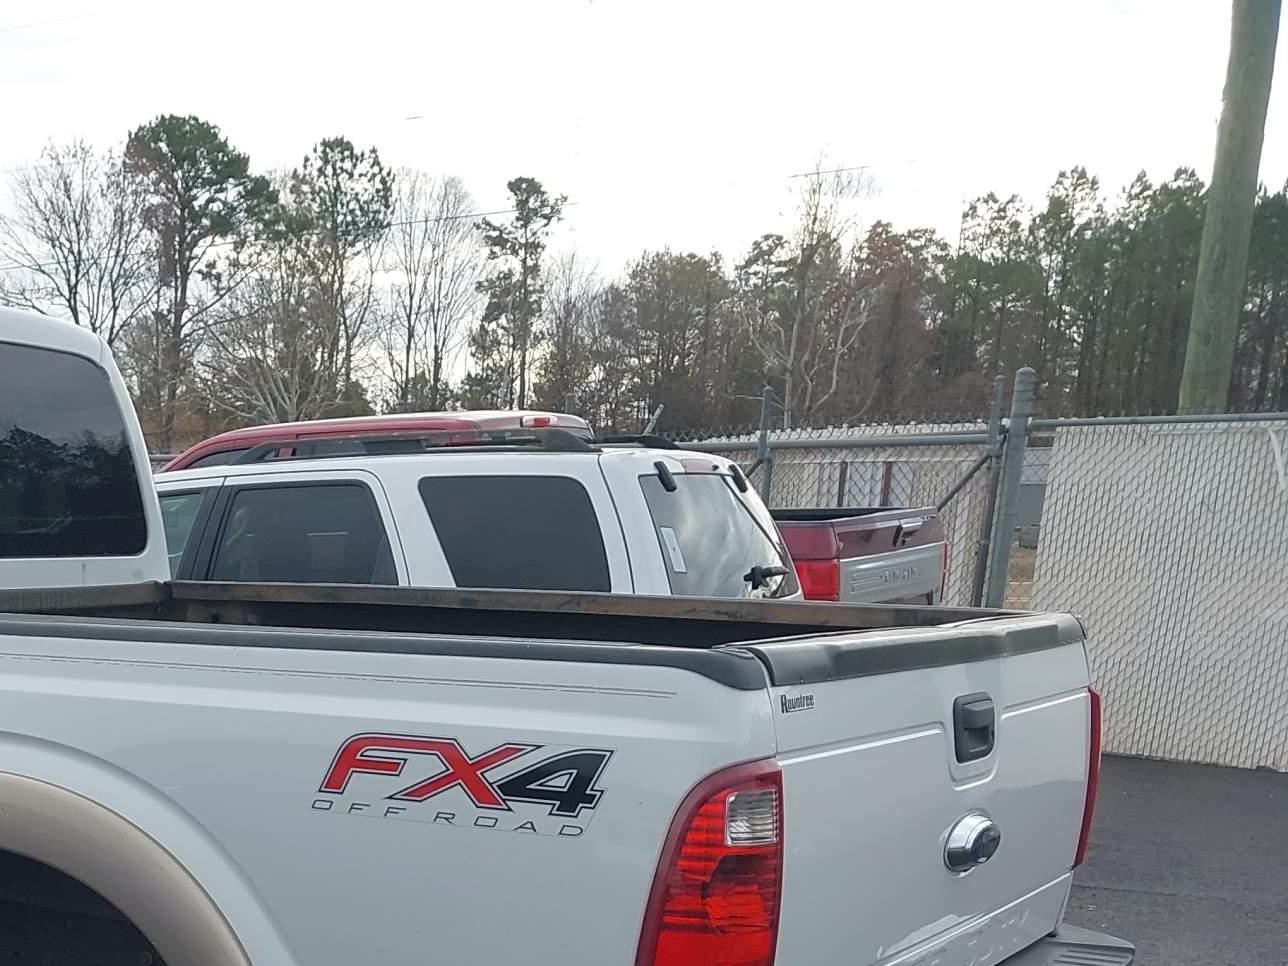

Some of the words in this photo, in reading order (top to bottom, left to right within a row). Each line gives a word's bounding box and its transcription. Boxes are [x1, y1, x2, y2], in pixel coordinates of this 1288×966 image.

[780, 694, 815, 714] Rountree
[318, 732, 614, 818] FX4
[312, 799, 407, 818] OFF
[433, 811, 584, 837] ROAD
